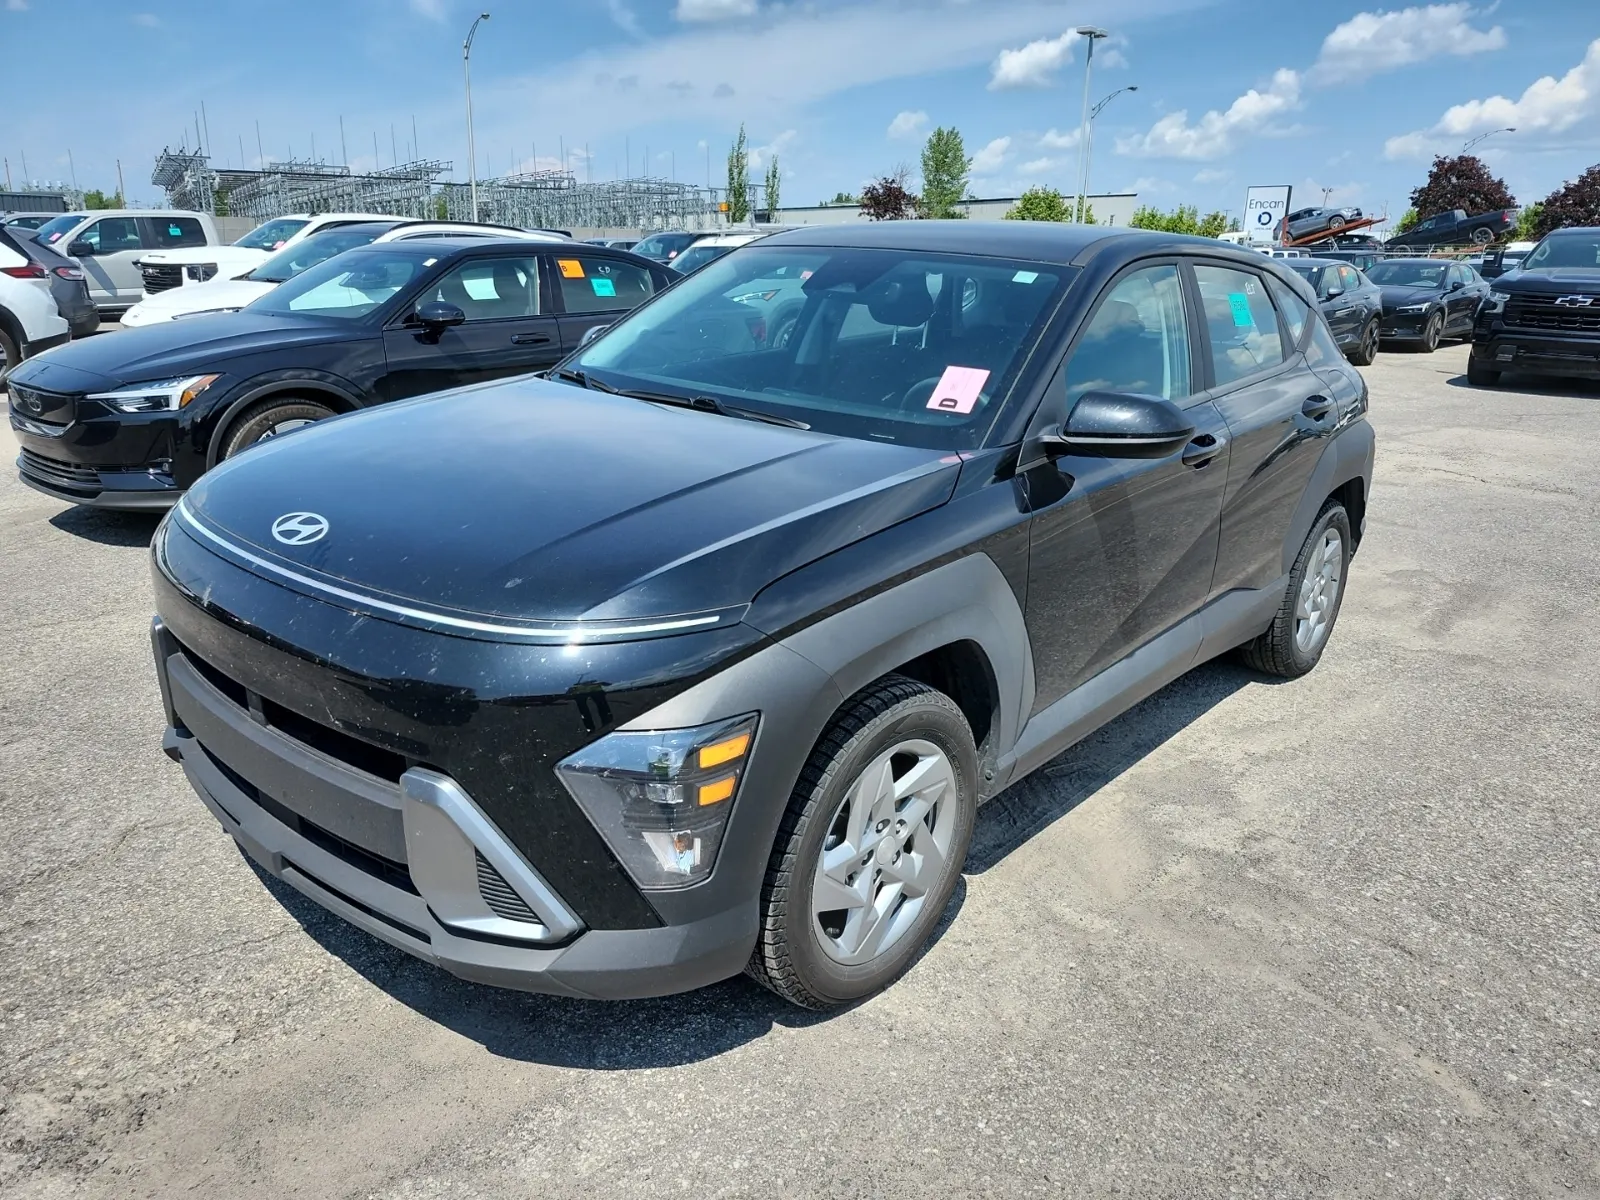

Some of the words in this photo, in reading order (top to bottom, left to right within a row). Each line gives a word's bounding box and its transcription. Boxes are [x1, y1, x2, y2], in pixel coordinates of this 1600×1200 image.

[1249, 198, 1285, 209] Encan
[938, 397, 958, 409] D
[268, 407, 315, 419] MICHELIN
